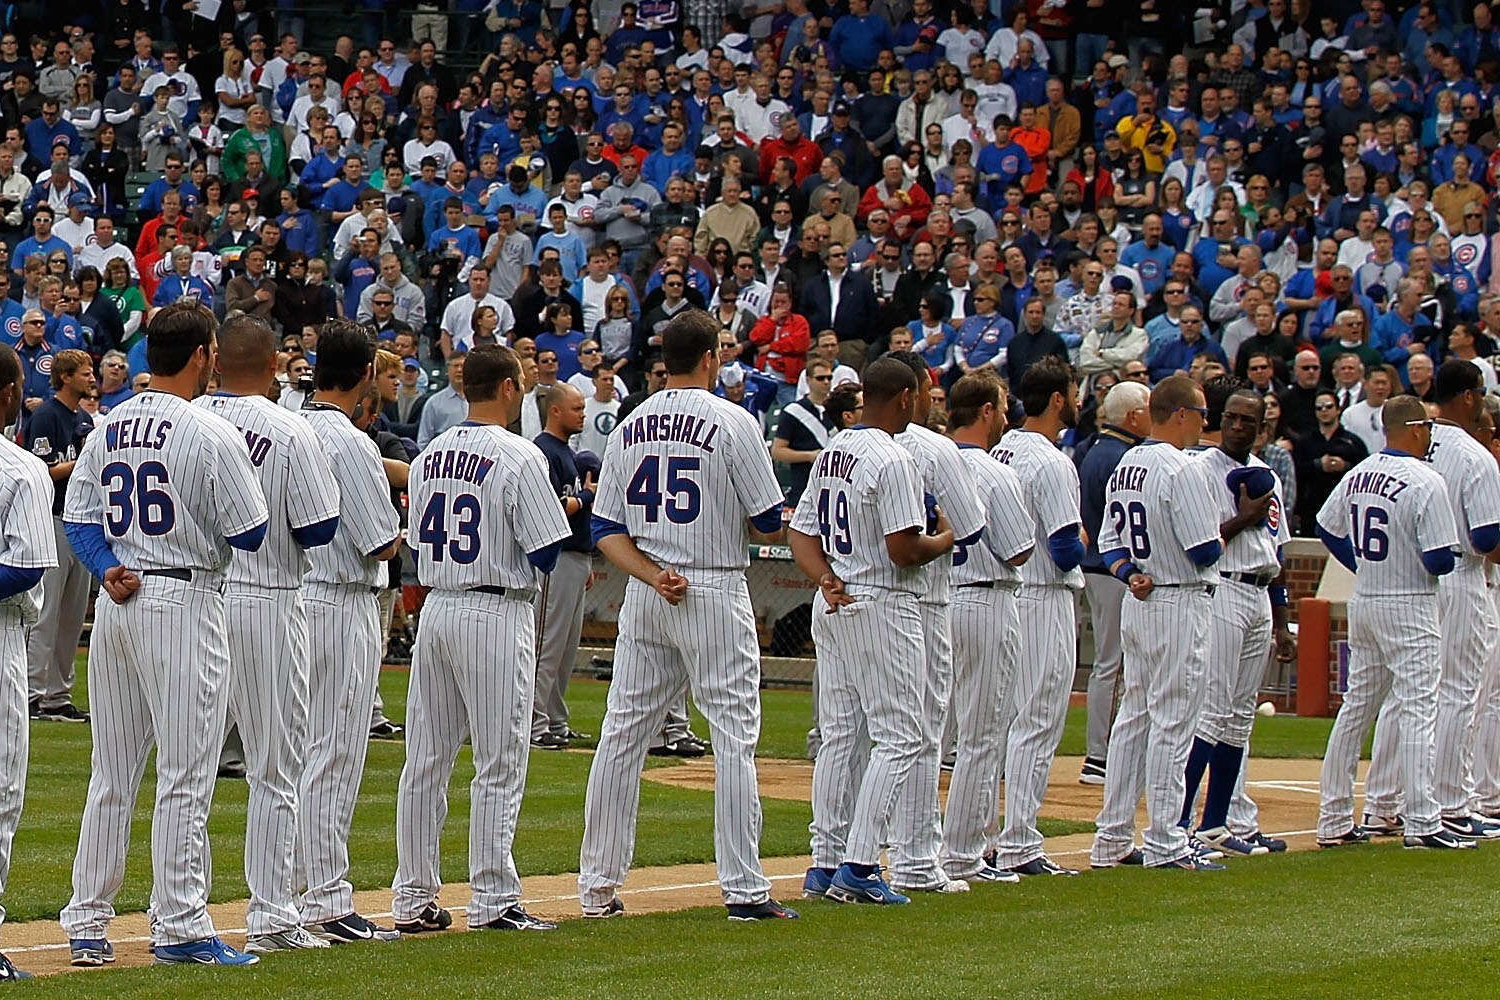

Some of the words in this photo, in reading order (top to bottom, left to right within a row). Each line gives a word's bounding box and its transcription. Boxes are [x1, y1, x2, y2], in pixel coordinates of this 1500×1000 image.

[107, 418, 172, 452] WELLS
[623, 414, 719, 453] MARSHALL
[424, 450, 494, 486] GRABOW
[626, 456, 701, 524] 45
[1111, 466, 1148, 493] BAKER
[1346, 472, 1408, 503] RAMIREZ
[101, 461, 175, 537] 36
[419, 491, 482, 565] 43
[818, 488, 852, 555] 49
[1110, 501, 1152, 560] 28
[1350, 503, 1389, 561] 16
